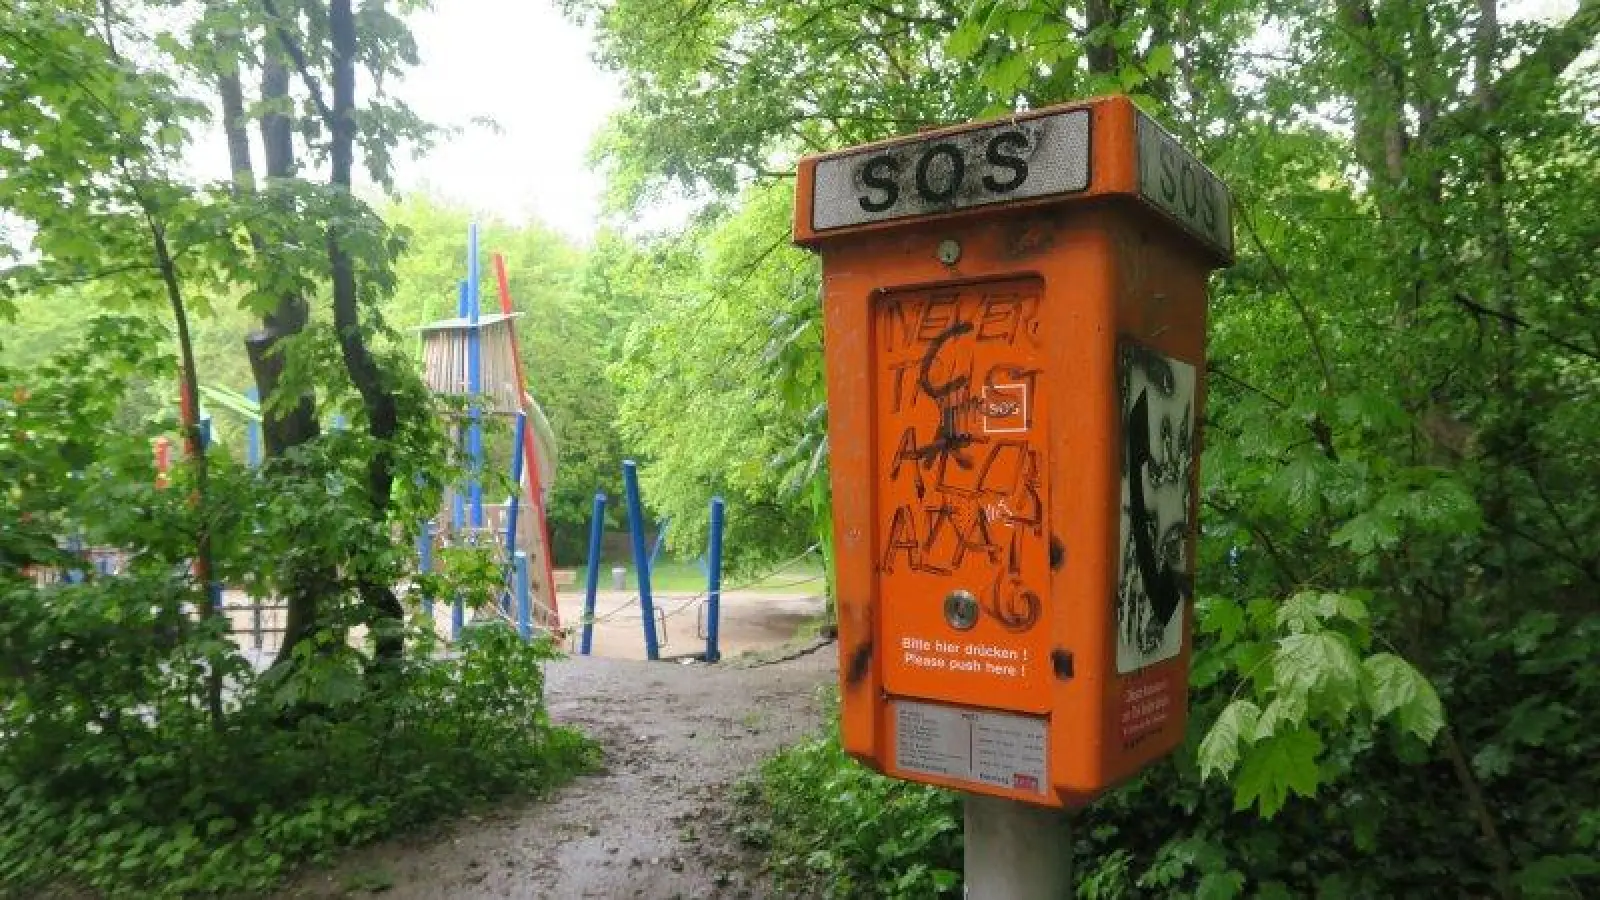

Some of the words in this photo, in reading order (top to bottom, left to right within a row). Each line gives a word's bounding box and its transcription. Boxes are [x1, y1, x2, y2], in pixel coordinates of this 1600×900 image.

[859, 131, 1029, 213] SOS
[1158, 142, 1216, 235] SOS
[902, 637, 931, 651] Bitte
[935, 639, 960, 653] hier
[904, 652, 945, 668] Please
[949, 659, 981, 673] push
[985, 662, 1017, 677] here
